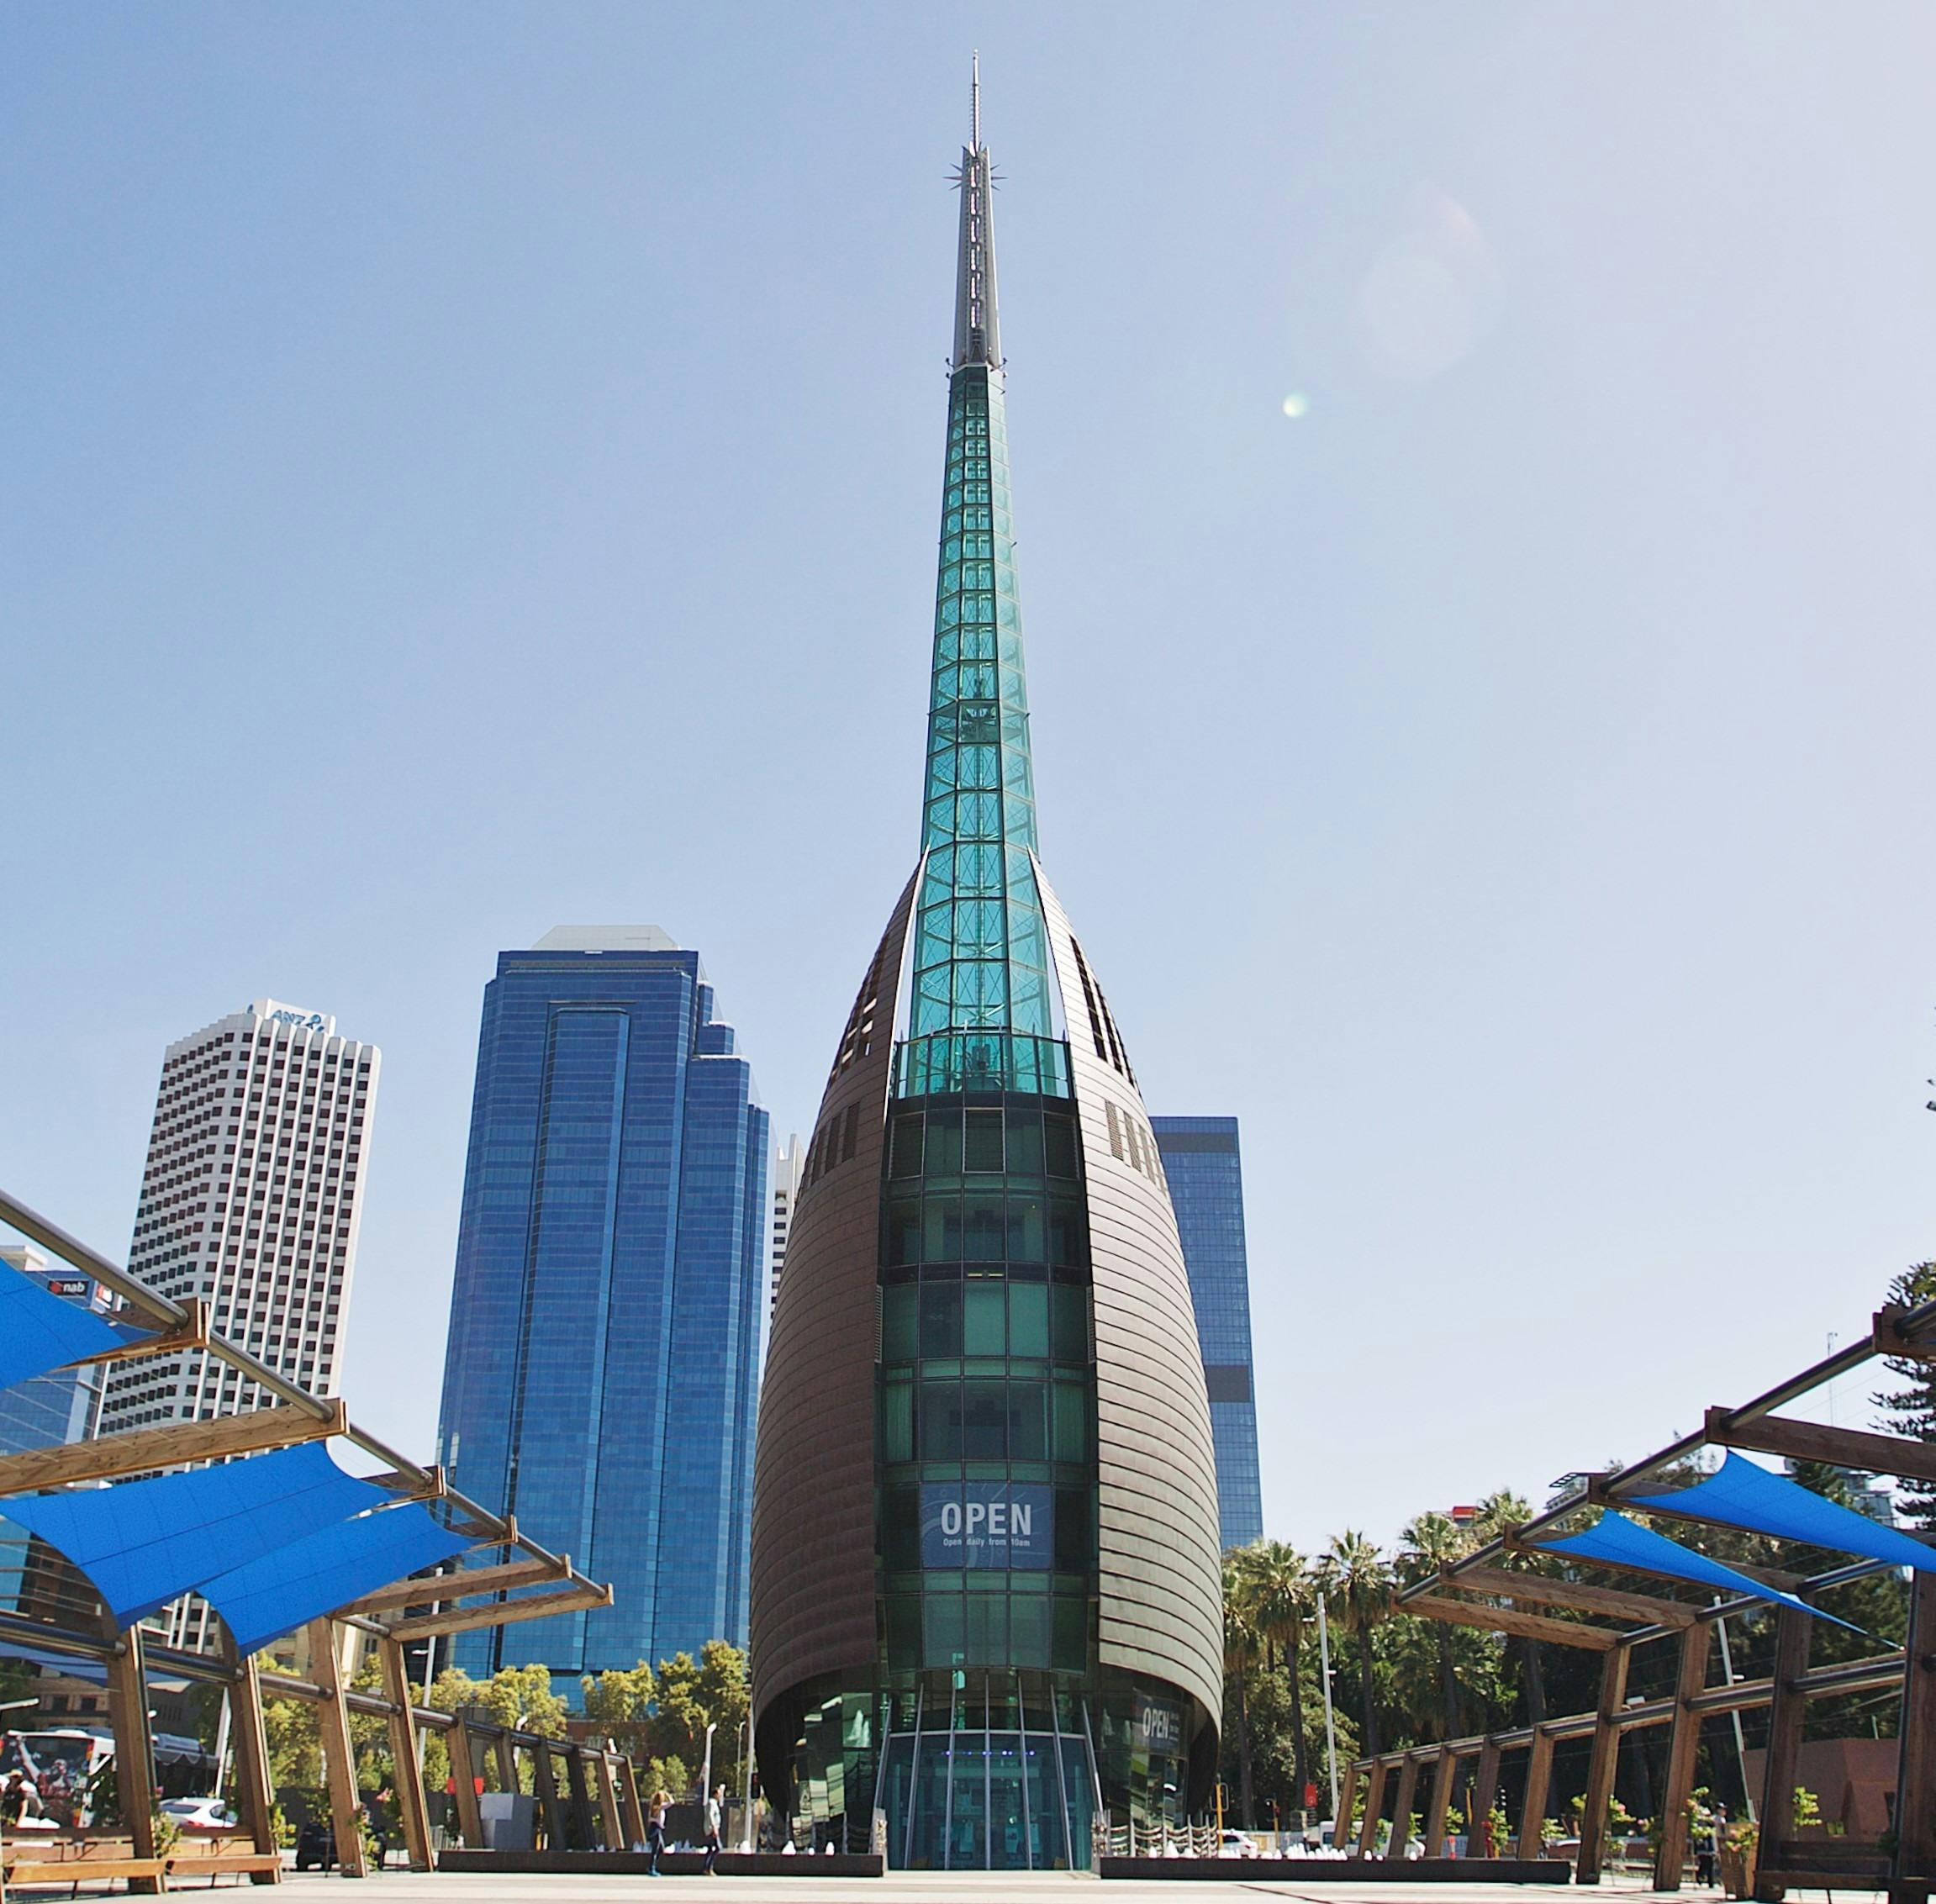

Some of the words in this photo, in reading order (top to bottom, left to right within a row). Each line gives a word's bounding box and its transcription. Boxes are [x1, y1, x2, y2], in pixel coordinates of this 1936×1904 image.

[272, 1010, 306, 1025] ANZ
[63, 1282, 85, 1293] nab
[941, 1502, 1031, 1536] OPEN
[942, 1537, 963, 1548] Open
[966, 1537, 985, 1548] daily
[988, 1537, 1007, 1546] from
[1010, 1538, 1031, 1547] 10am
[1143, 1707, 1169, 1740] OPEN
